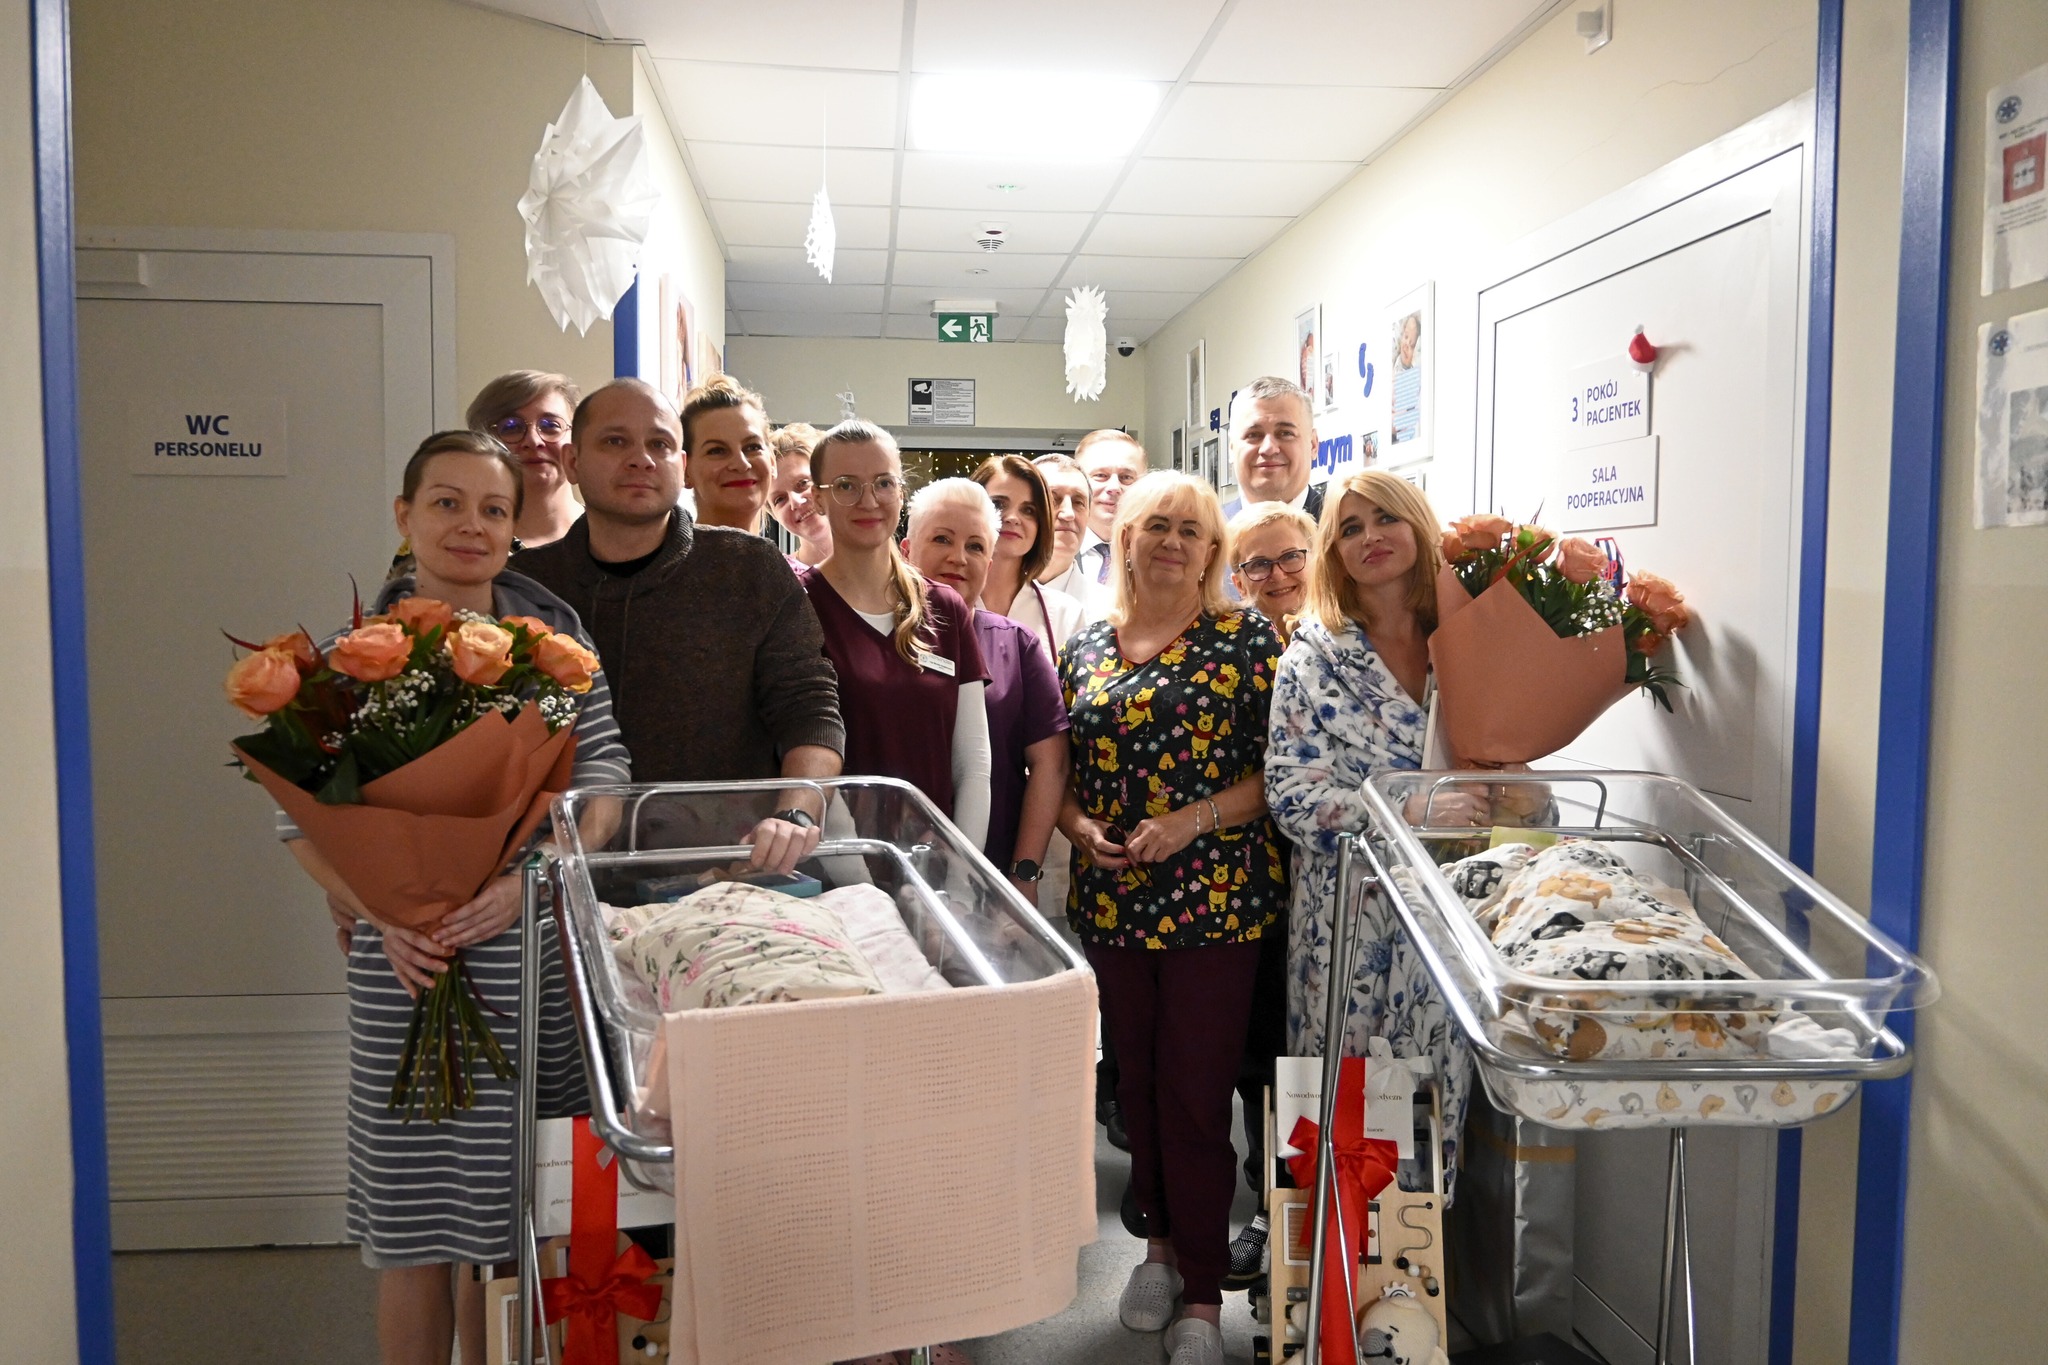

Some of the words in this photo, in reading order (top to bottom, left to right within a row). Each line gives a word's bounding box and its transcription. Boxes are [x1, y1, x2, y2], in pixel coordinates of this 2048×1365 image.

[1587, 379, 1618, 403] POKÓJ
[1572, 397, 1579, 423] 3
[1587, 400, 1641, 427] PACJENTEK
[185, 414, 230, 436] WC
[154, 442, 262, 457] PERSONELU
[1311, 434, 1353, 475] wym
[1592, 465, 1617, 484] SALA
[1567, 486, 1644, 510] POOPERACYJNA
